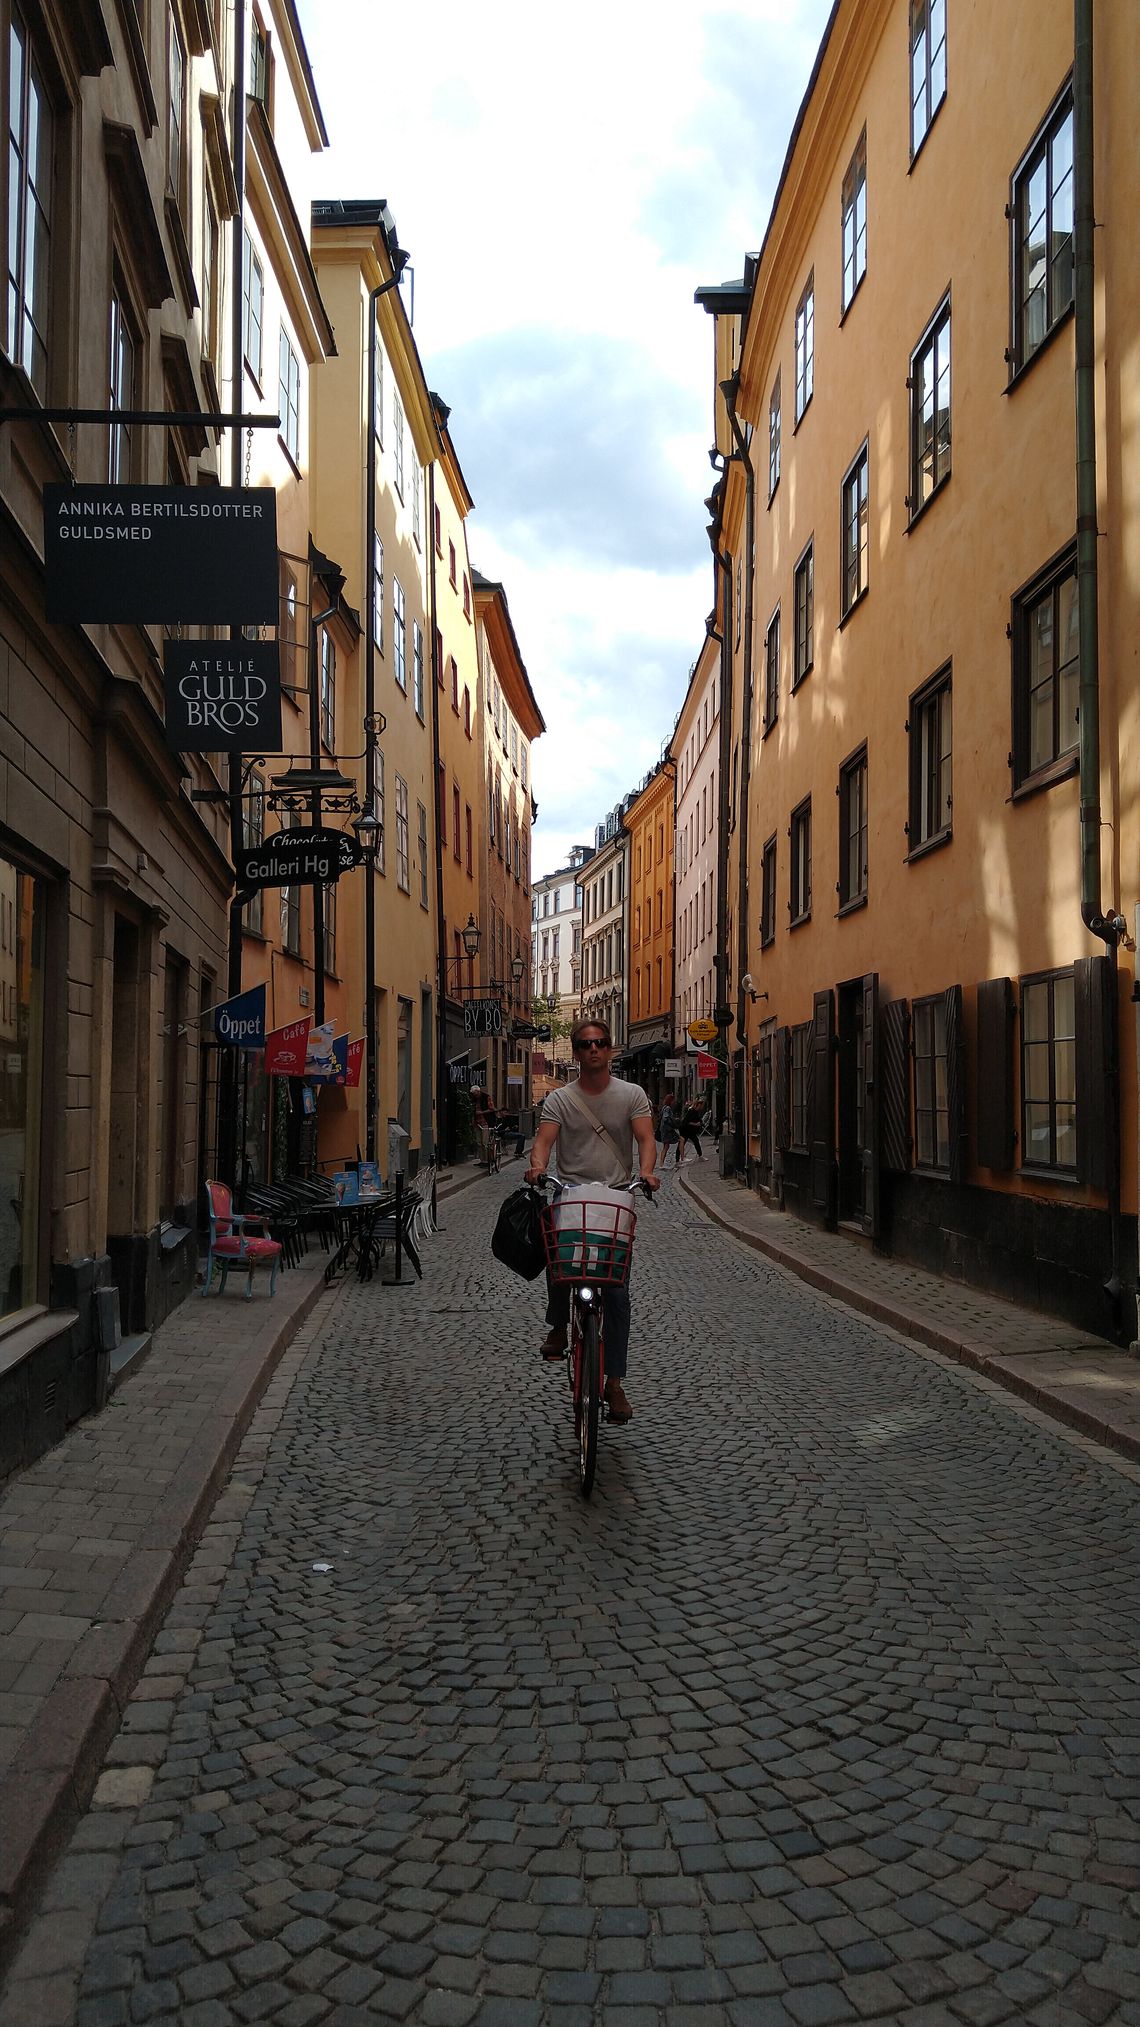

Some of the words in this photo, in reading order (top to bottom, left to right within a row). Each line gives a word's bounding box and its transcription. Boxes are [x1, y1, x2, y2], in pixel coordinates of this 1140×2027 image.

[58, 502, 125, 516] ANNIKA
[131, 503, 263, 518] BERTILSDOTTER
[59, 525, 152, 540] GULDSMED
[189, 658, 255, 674] ATELJÉ
[178, 675, 267, 700] GULD
[186, 701, 259, 735] BROS
[245, 857, 300, 879] Galleri
[304, 854, 329, 877] Hg
[219, 1009, 261, 1040] Öppet
[283, 1023, 305, 1041] Café
[464, 1008, 479, 1032] BY
[485, 1008, 502, 1031] BO
